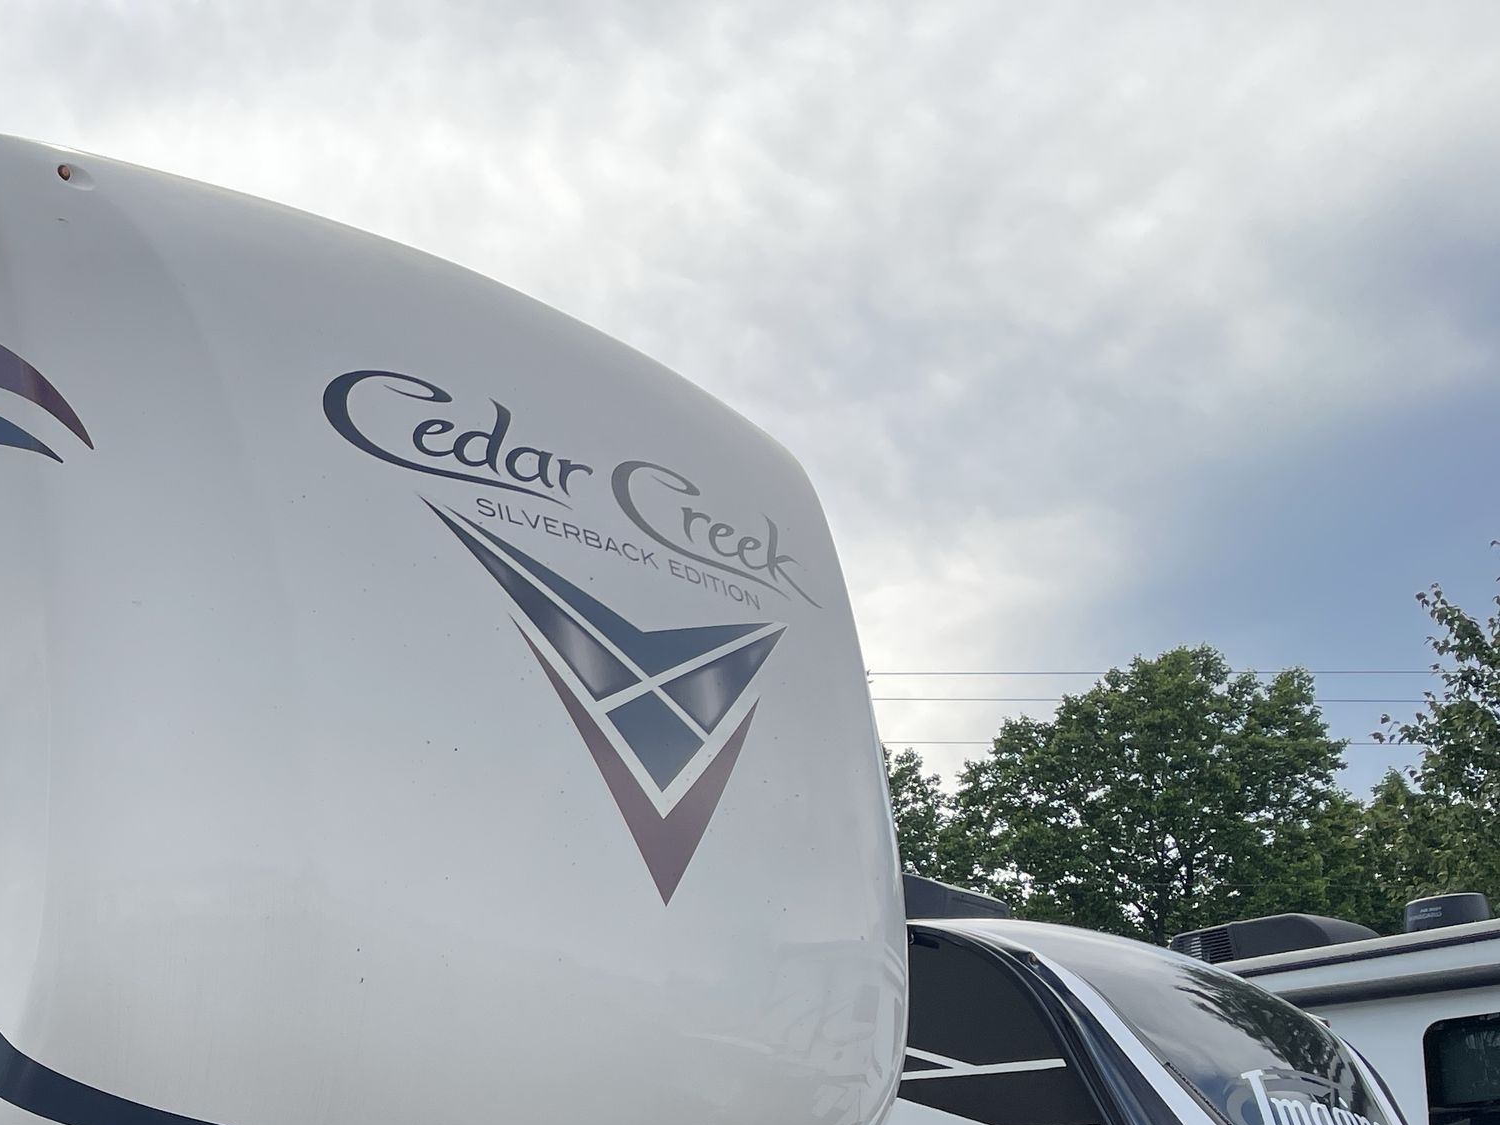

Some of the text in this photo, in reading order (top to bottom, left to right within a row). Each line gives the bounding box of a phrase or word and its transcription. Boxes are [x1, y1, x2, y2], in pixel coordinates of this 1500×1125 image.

[323, 370, 823, 609] Cedar Creek
[476, 497, 761, 611] SILVERBACK EDITION
